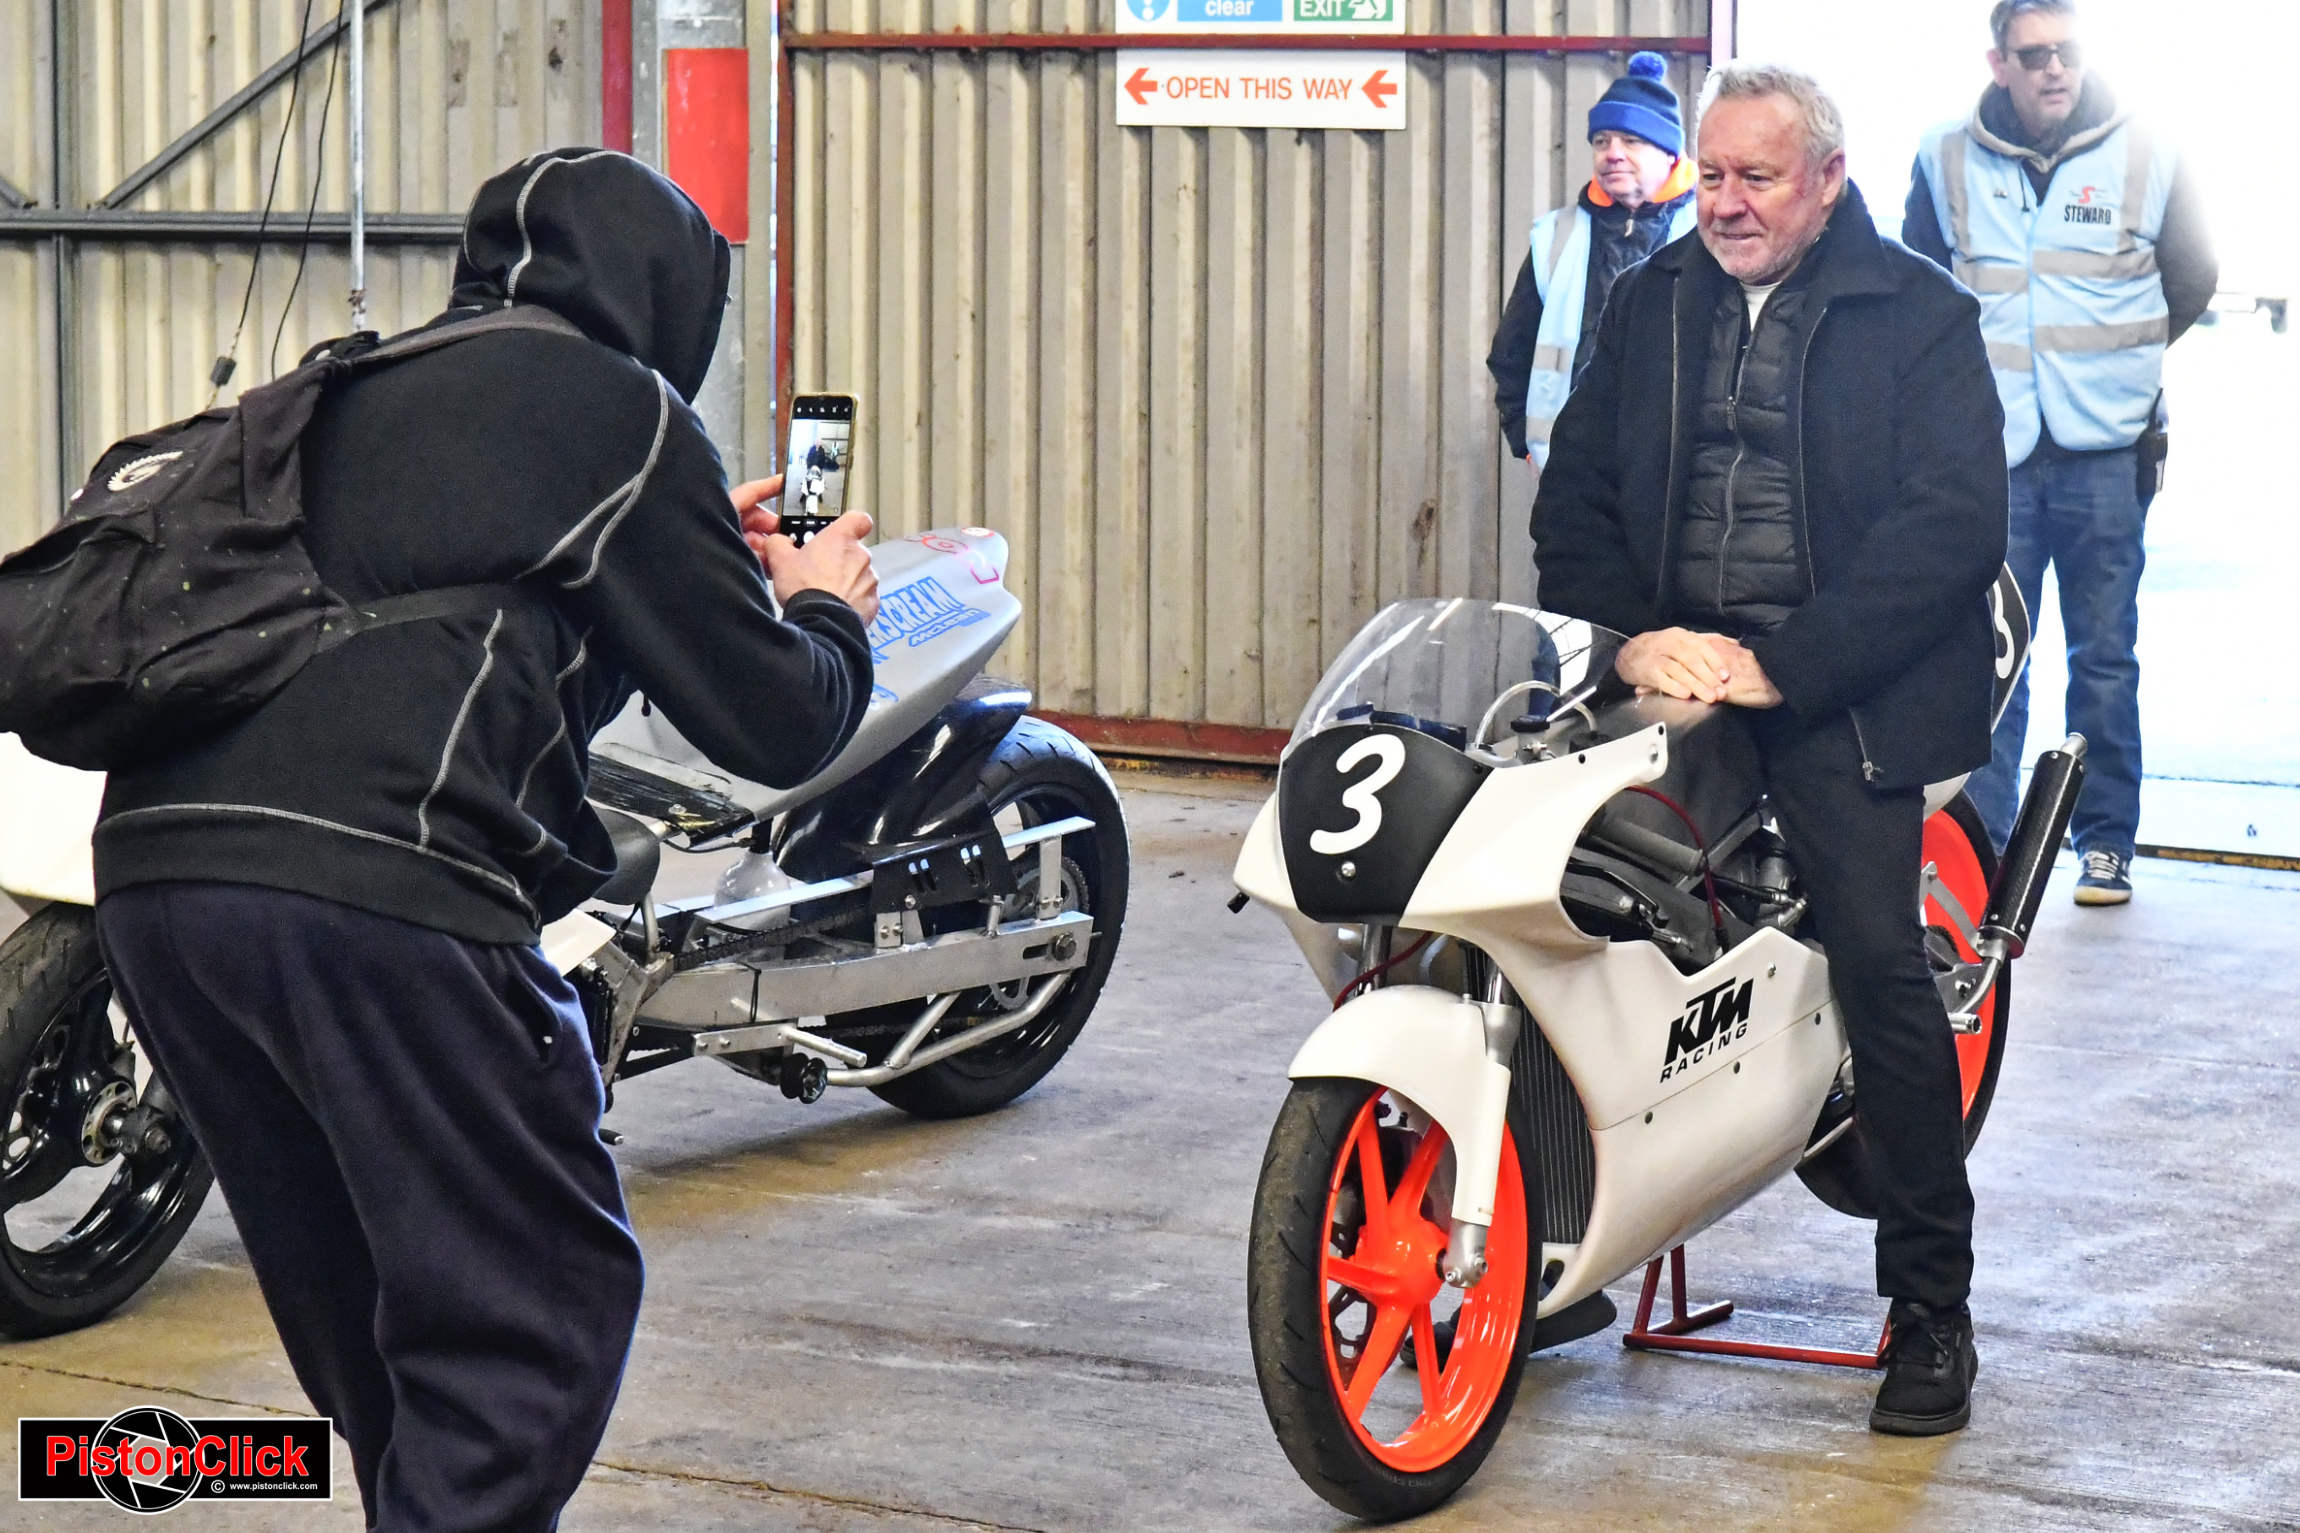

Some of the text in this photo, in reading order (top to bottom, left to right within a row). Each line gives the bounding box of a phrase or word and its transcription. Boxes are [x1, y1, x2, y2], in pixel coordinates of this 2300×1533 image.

[1205, 0, 1254, 16] clear
[1300, 0, 1342, 17] EXIT
[1166, 76, 1353, 100] OPEN THIS WAY
[2064, 204, 2111, 225] STEWARD
[1309, 733, 1406, 855] 3
[1664, 976, 1754, 1066] KTM
[1660, 1022, 1748, 1083] RACING
